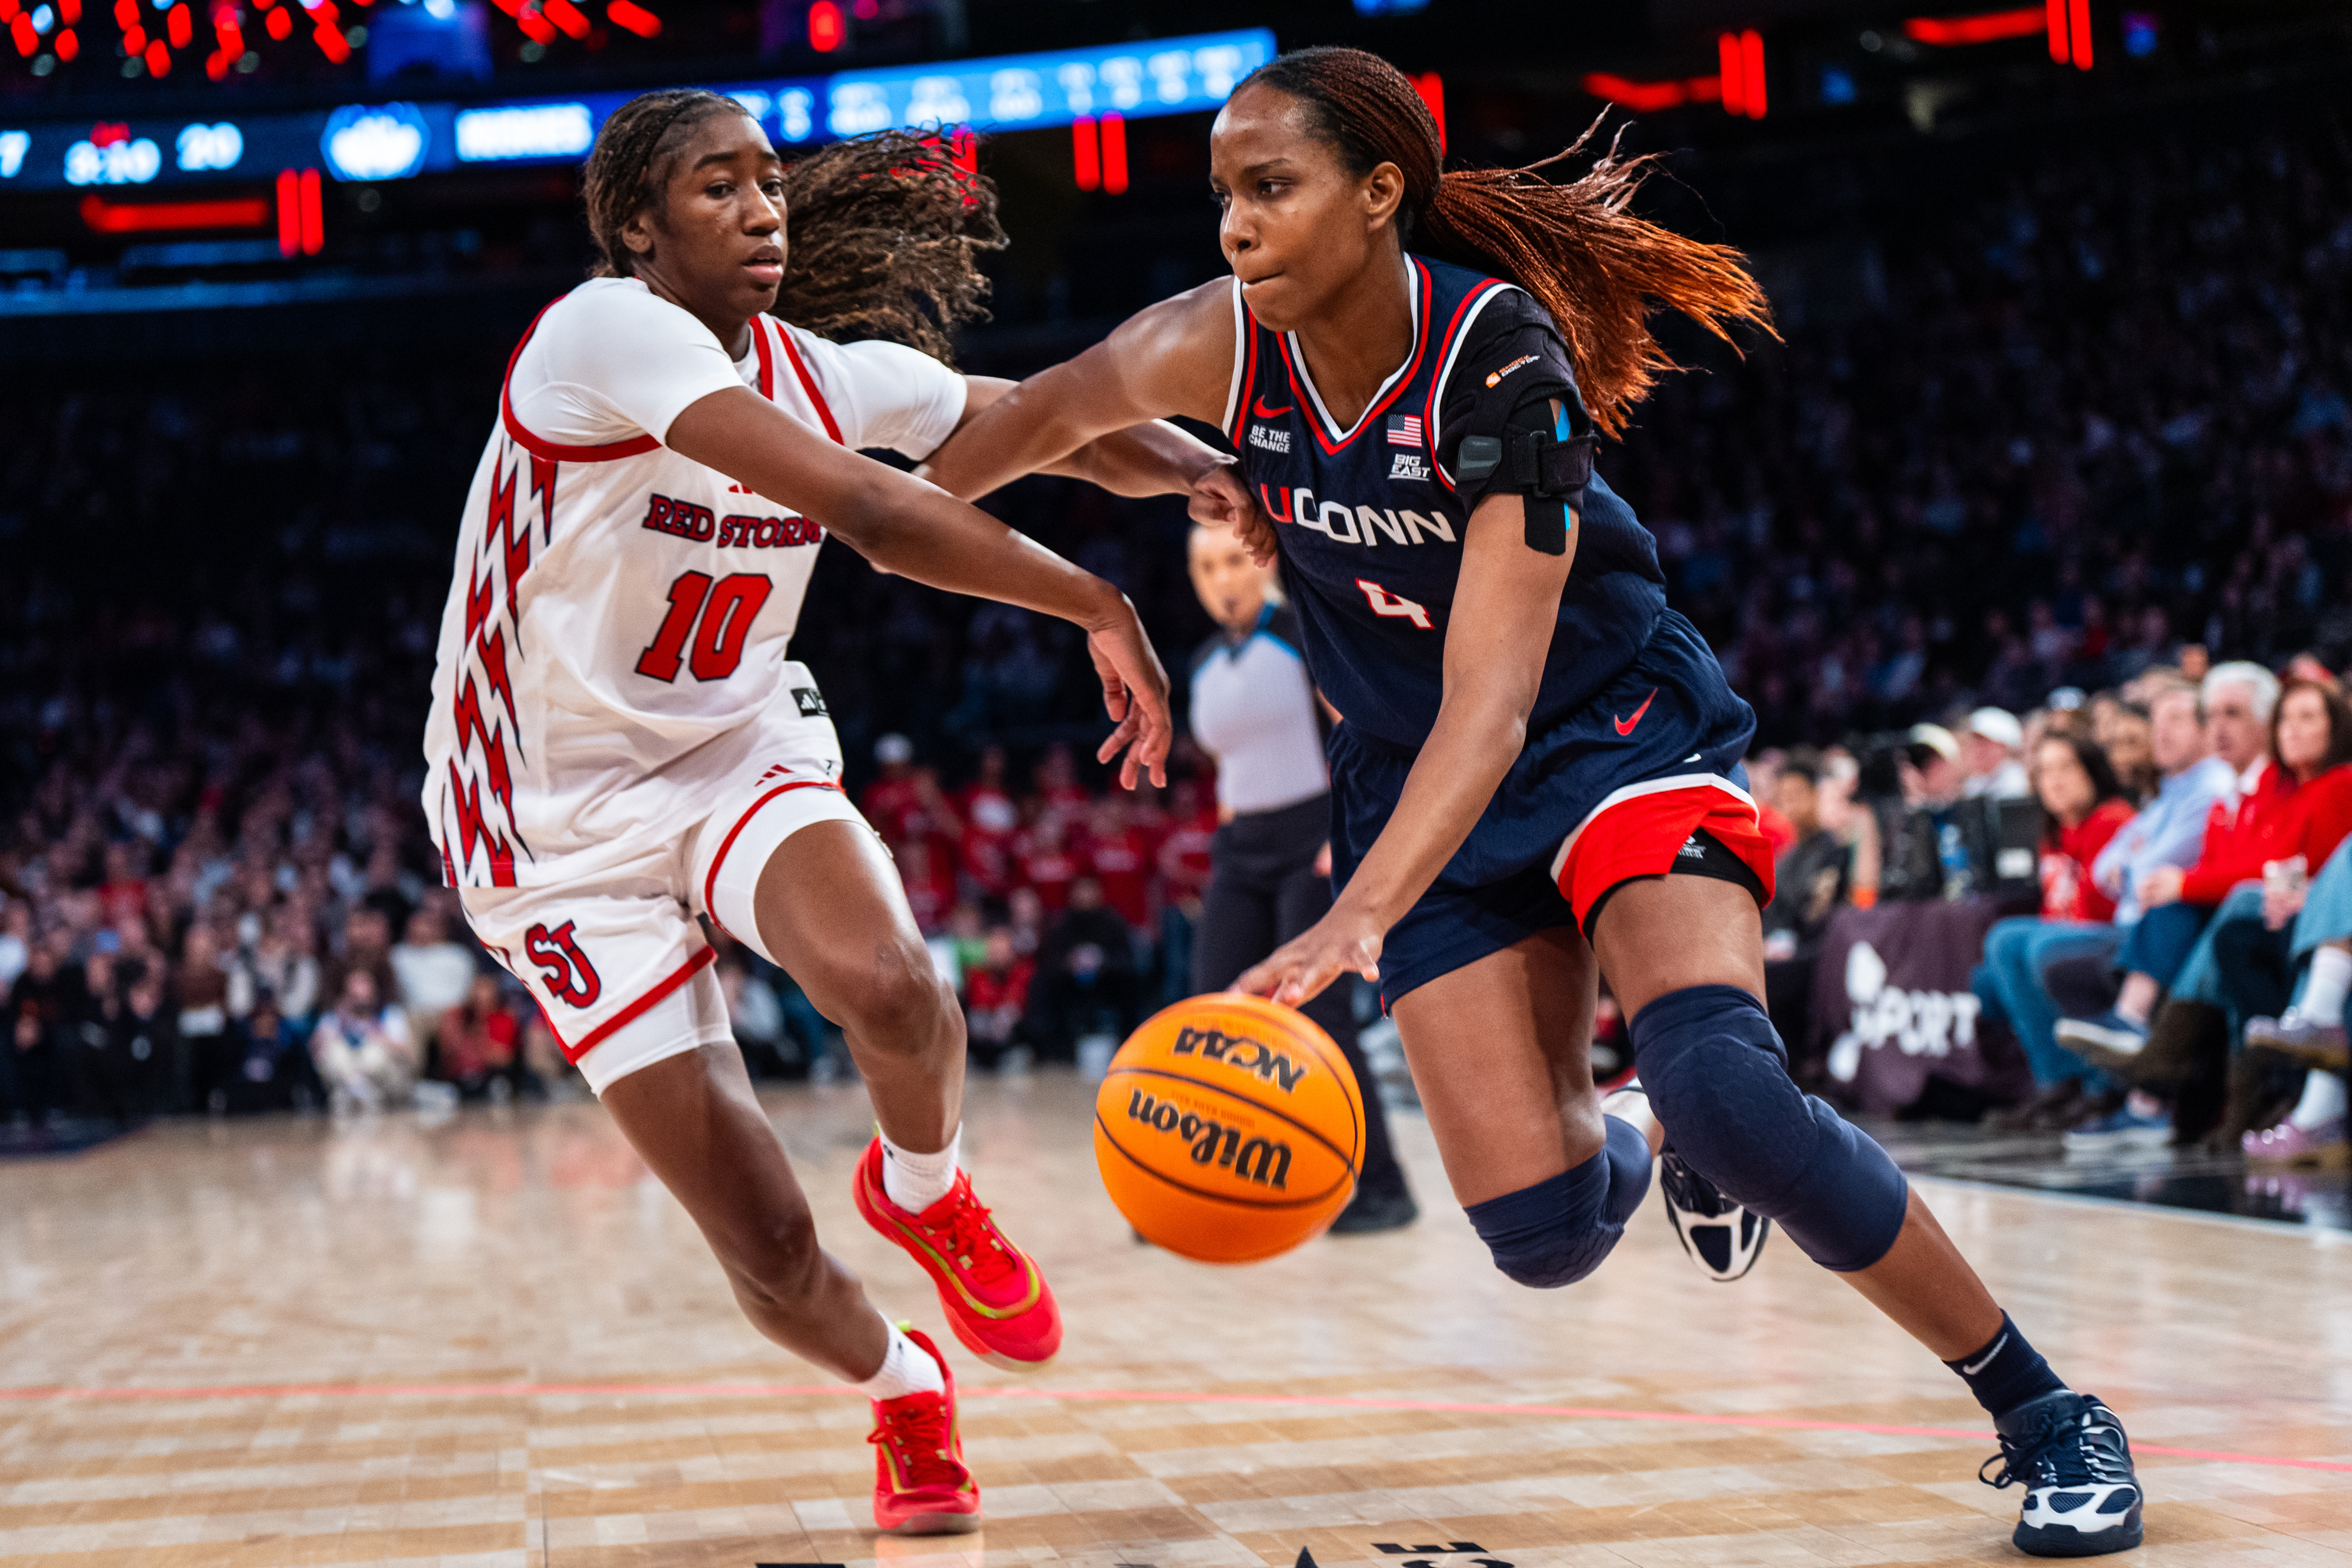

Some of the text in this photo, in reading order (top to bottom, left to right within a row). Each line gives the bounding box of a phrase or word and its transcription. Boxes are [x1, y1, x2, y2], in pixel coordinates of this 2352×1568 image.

[1248, 434, 1291, 454] CHANGE
[1251, 424, 1291, 444] BE THE
[1394, 453, 1421, 467] BIG
[1391, 463, 1431, 478] EAST
[642, 493, 821, 549] RED STORM
[1260, 483, 1457, 547] UCONN
[634, 569, 774, 684] 10
[1355, 577, 1436, 630] 4
[1172, 1025, 1308, 1095] NCAA
[1127, 1087, 1293, 1190] Wilson
